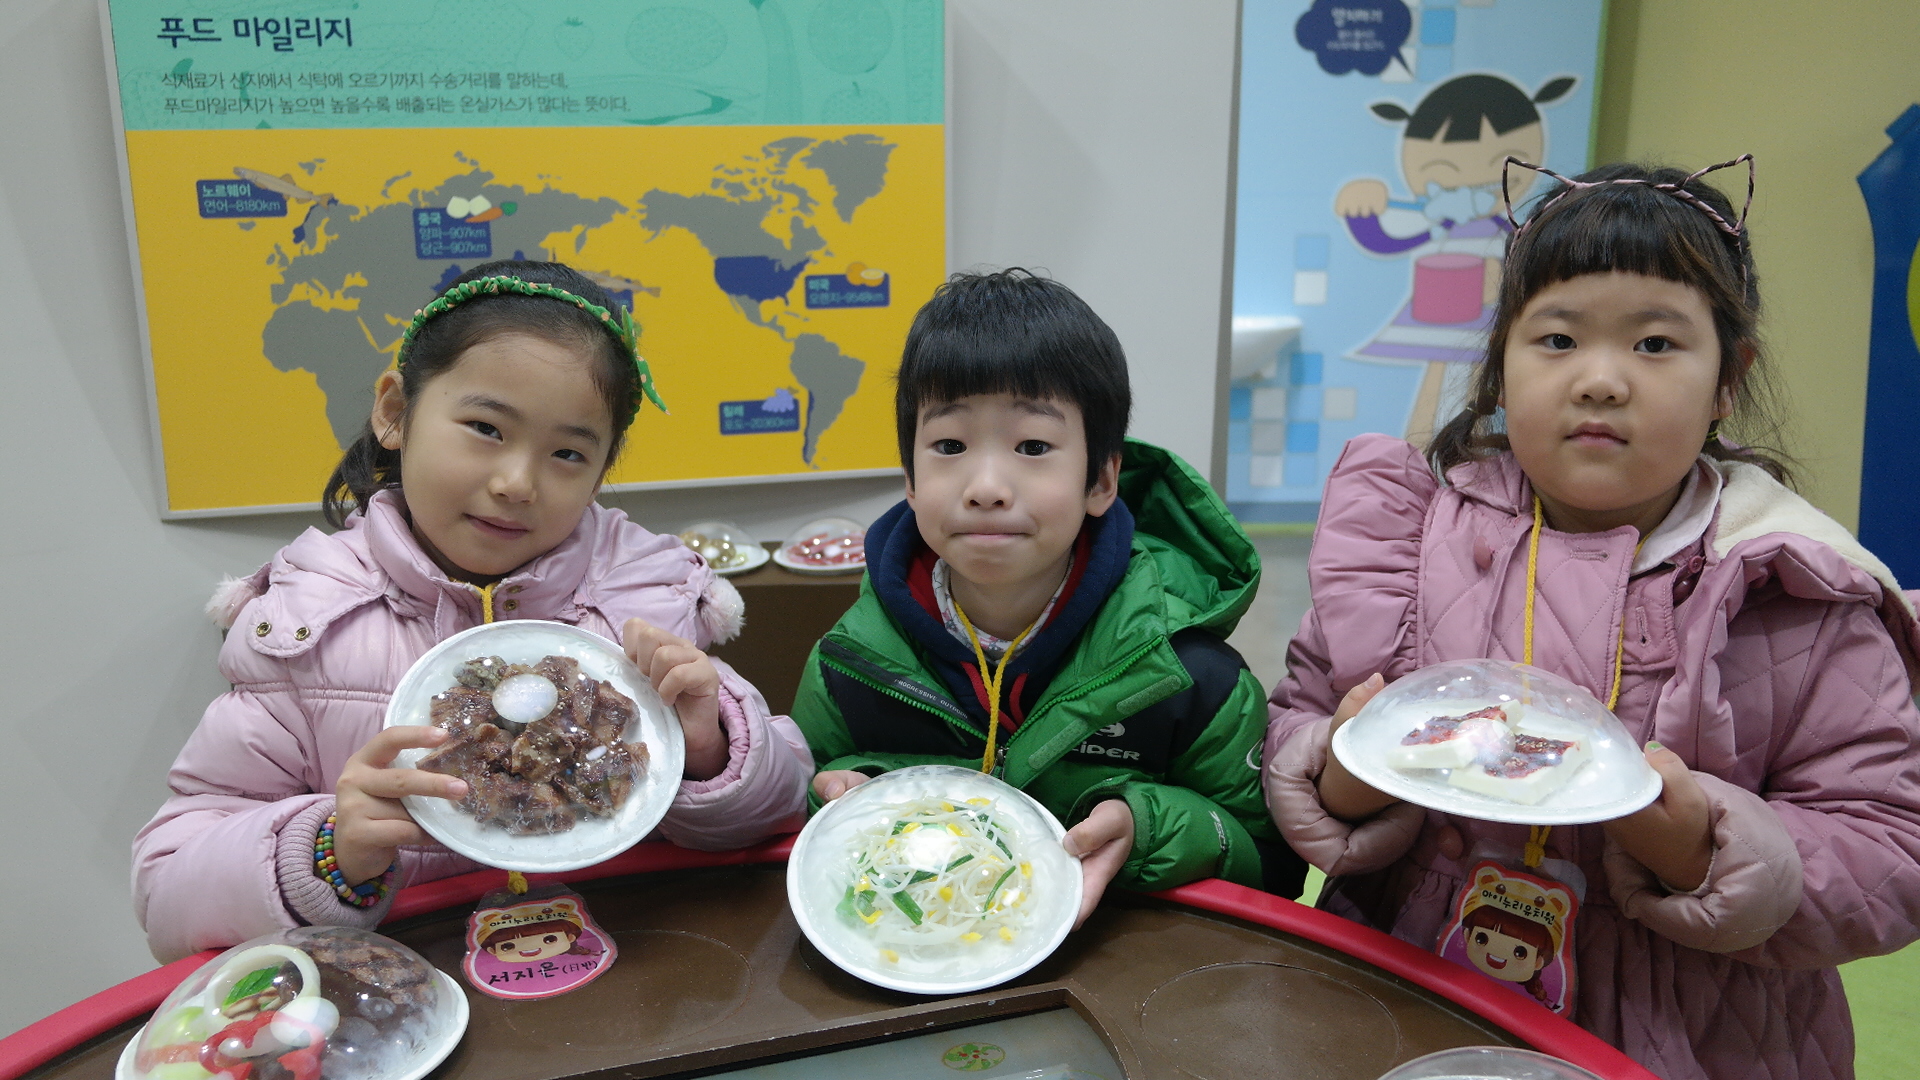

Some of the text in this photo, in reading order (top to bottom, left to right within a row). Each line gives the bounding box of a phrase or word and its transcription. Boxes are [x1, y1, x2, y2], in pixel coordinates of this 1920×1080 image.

[157, 17, 352, 52] 푸드 마일리지
[161, 72, 225, 89] 식재료가
[230, 72, 292, 89] 산지에서
[297, 72, 344, 89] 식탁에
[348, 72, 423, 88] 오르기까지
[429, 72, 501, 89] 수송거리를
[164, 97, 274, 115] 푸드마일리지가
[279, 97, 325, 114] 높으면
[330, 96, 390, 114] 높을수록
[396, 96, 455, 114] 배출되는
[460, 96, 532, 113] 온실가스가
[537, 96, 580, 113] 많다는
[203, 184, 251, 197] 노르웨이
[419, 212, 441, 226] 중국
[1072, 741, 1140, 761] iDER
[1482, 889, 1555, 925] 아이누리유치원
[489, 911, 569, 927] 아이누리유치원
[489, 961, 559, 986] 서지은
